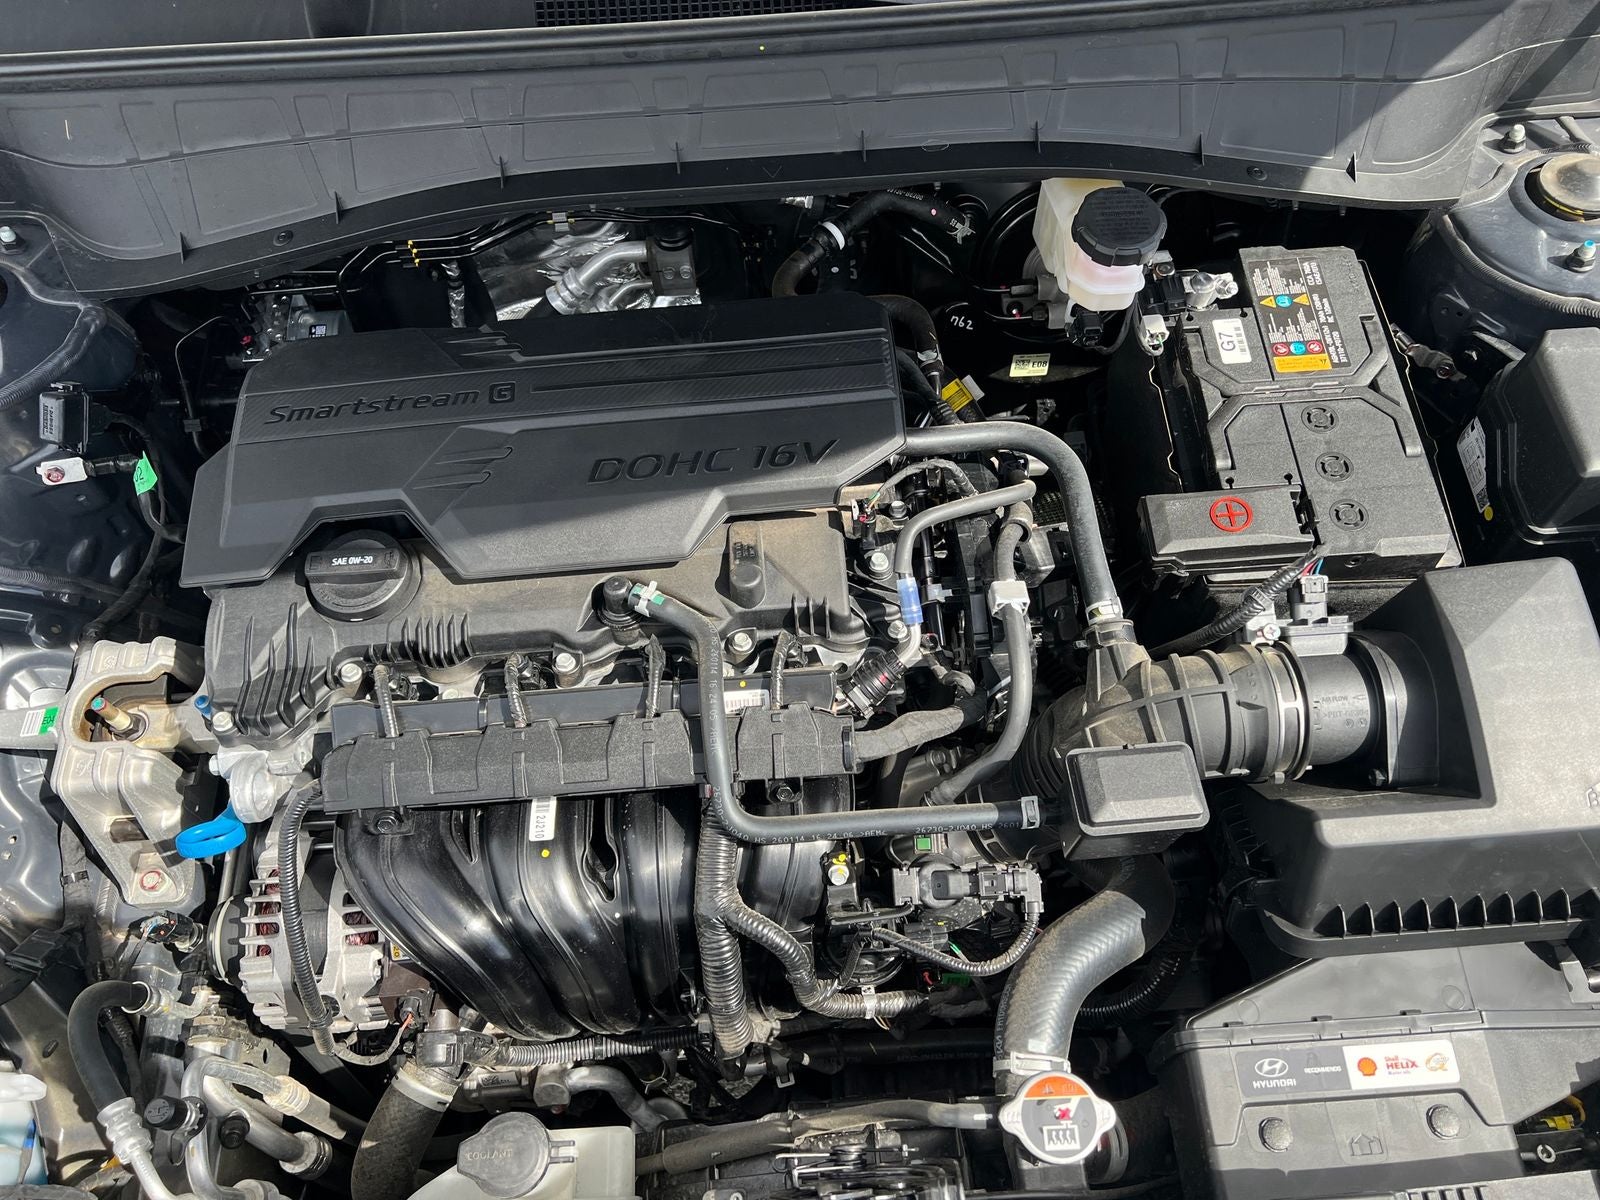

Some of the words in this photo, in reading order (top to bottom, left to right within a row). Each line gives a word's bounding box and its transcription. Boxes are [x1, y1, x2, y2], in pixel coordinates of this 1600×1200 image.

[1218, 332, 1236, 352] G7
[1031, 360, 1048, 368] E08
[263, 389, 480, 425] Smartstream
[488, 381, 516, 404] G
[587, 447, 741, 485] DOHC
[753, 438, 840, 471] 16V
[331, 557, 348, 566] SAE
[348, 555, 374, 565] 0W-20
[771, 836, 805, 844] 260114
[1303, 1065, 1342, 1074] RECOMMENDS
[1386, 1061, 1420, 1070] HELIX
[1252, 1078, 1297, 1090] HYUNDAI
[465, 1148, 513, 1161] COOLANT
